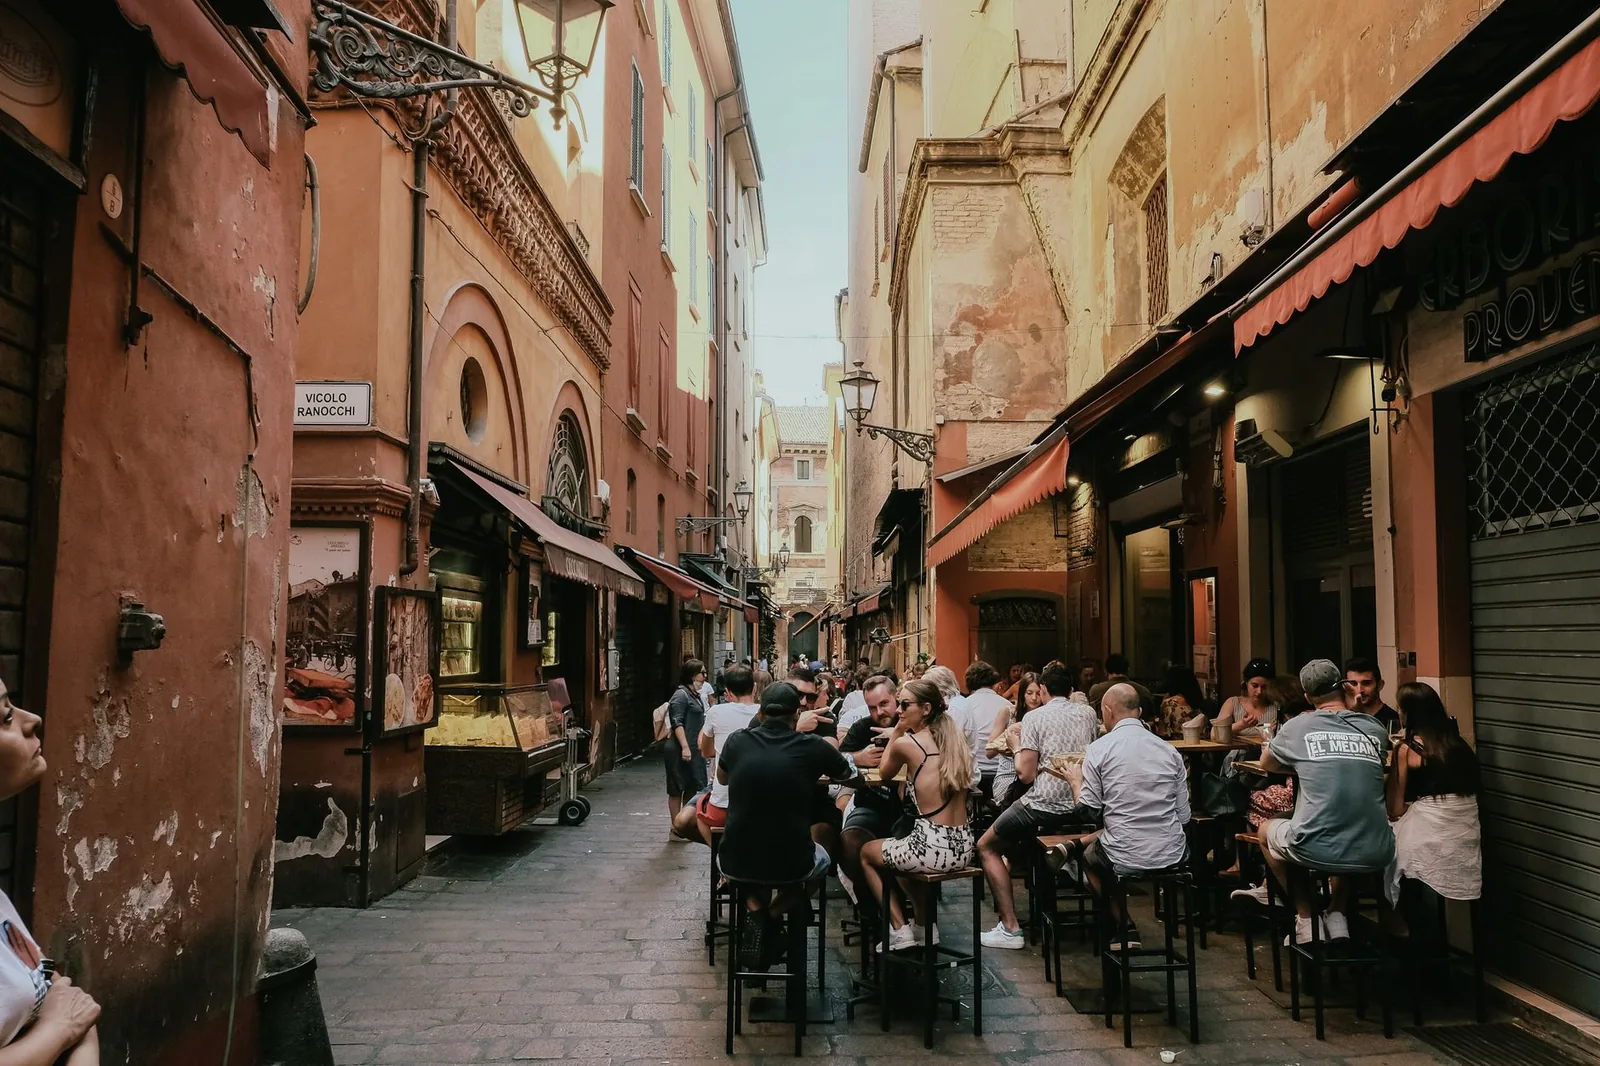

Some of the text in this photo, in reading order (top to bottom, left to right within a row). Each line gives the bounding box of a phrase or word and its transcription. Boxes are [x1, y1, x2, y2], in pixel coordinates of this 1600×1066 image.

[1418, 140, 1600, 312] ERBORI
[305, 393, 347, 403] VICOLO
[297, 406, 355, 417] RANOCCHI
[1310, 741, 1326, 753] EL
